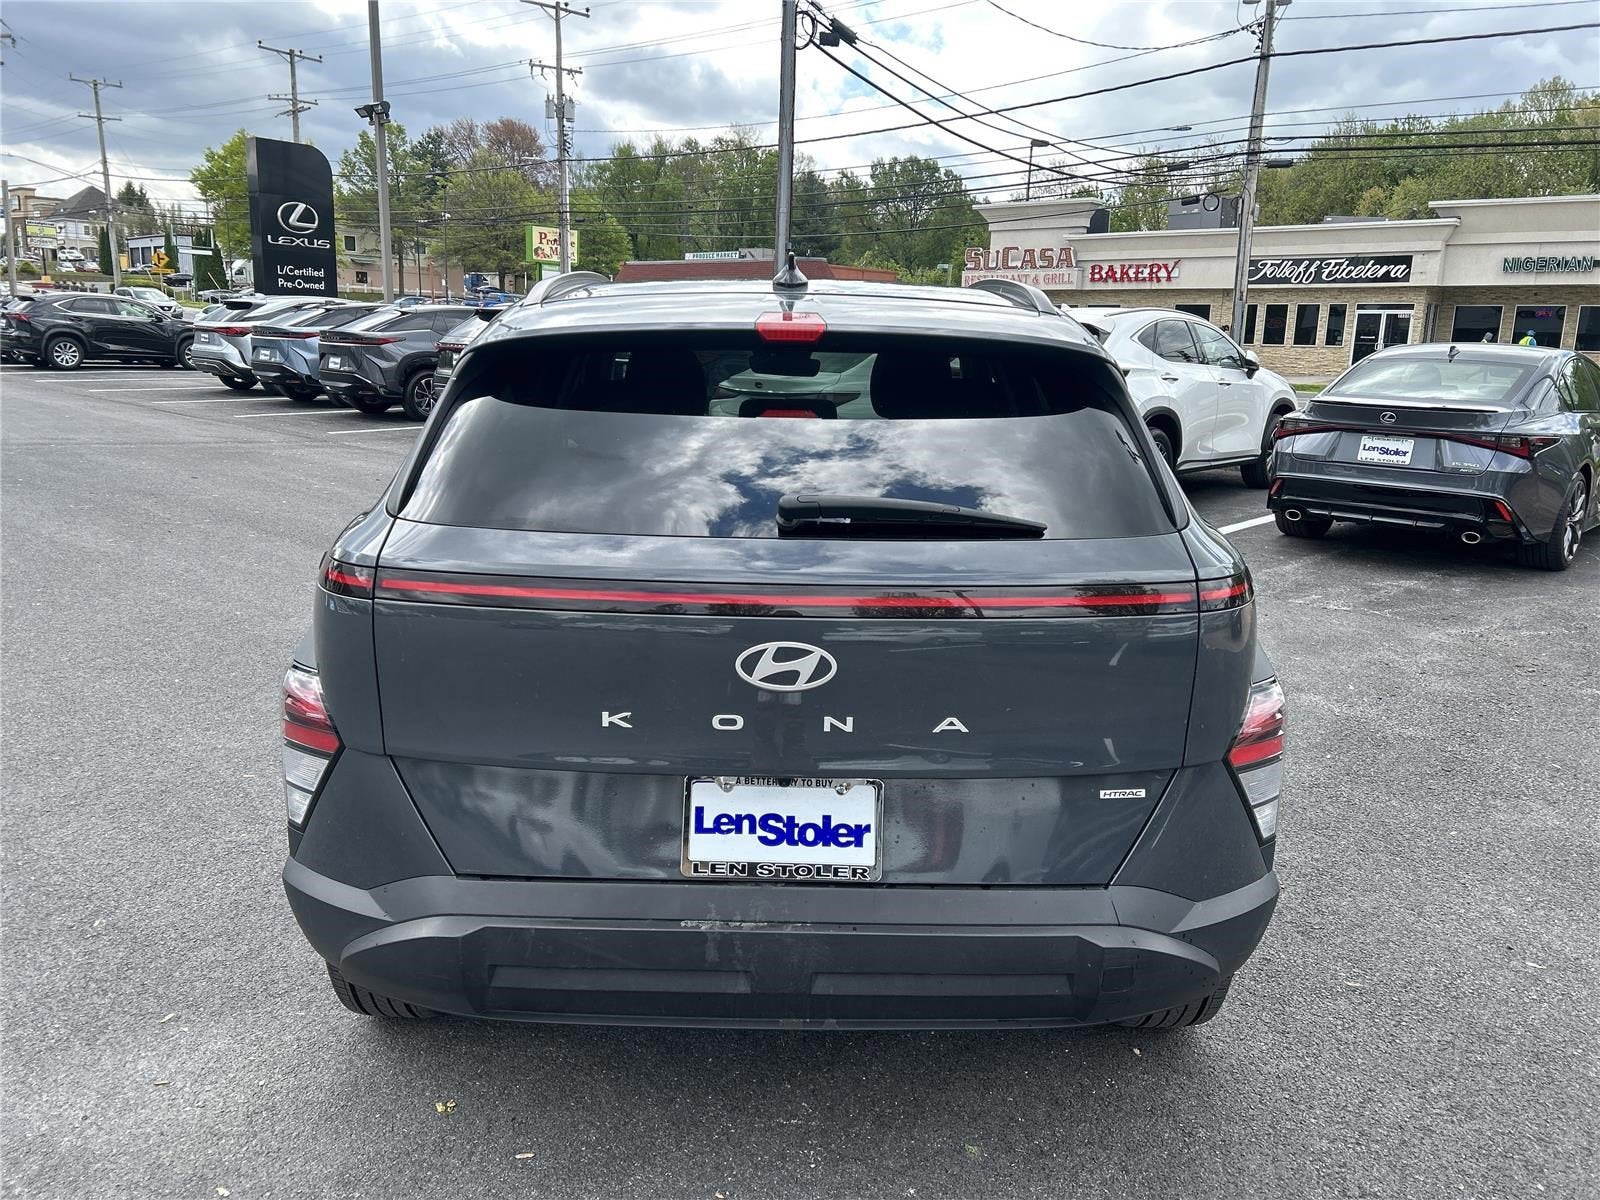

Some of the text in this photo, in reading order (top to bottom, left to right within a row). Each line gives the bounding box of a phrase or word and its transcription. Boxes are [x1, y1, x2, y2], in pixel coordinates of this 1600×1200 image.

[267, 235, 330, 249] LEXUS
[277, 265, 325, 277] L/Certified
[1089, 259, 1181, 283] BAKERY
[1321, 257, 1410, 281] Etcetera
[1502, 256, 1595, 273] NIGERIAN
[278, 278, 325, 290] Pre-Owned
[1032, 275, 1041, 284] &
[1043, 273, 1074, 285] GRILL
[735, 777, 741, 785] A
[744, 777, 777, 786] BETTER
[801, 779, 813, 787] TO
[815, 779, 833, 787] BUY
[691, 861, 871, 880] LEN STOLER
